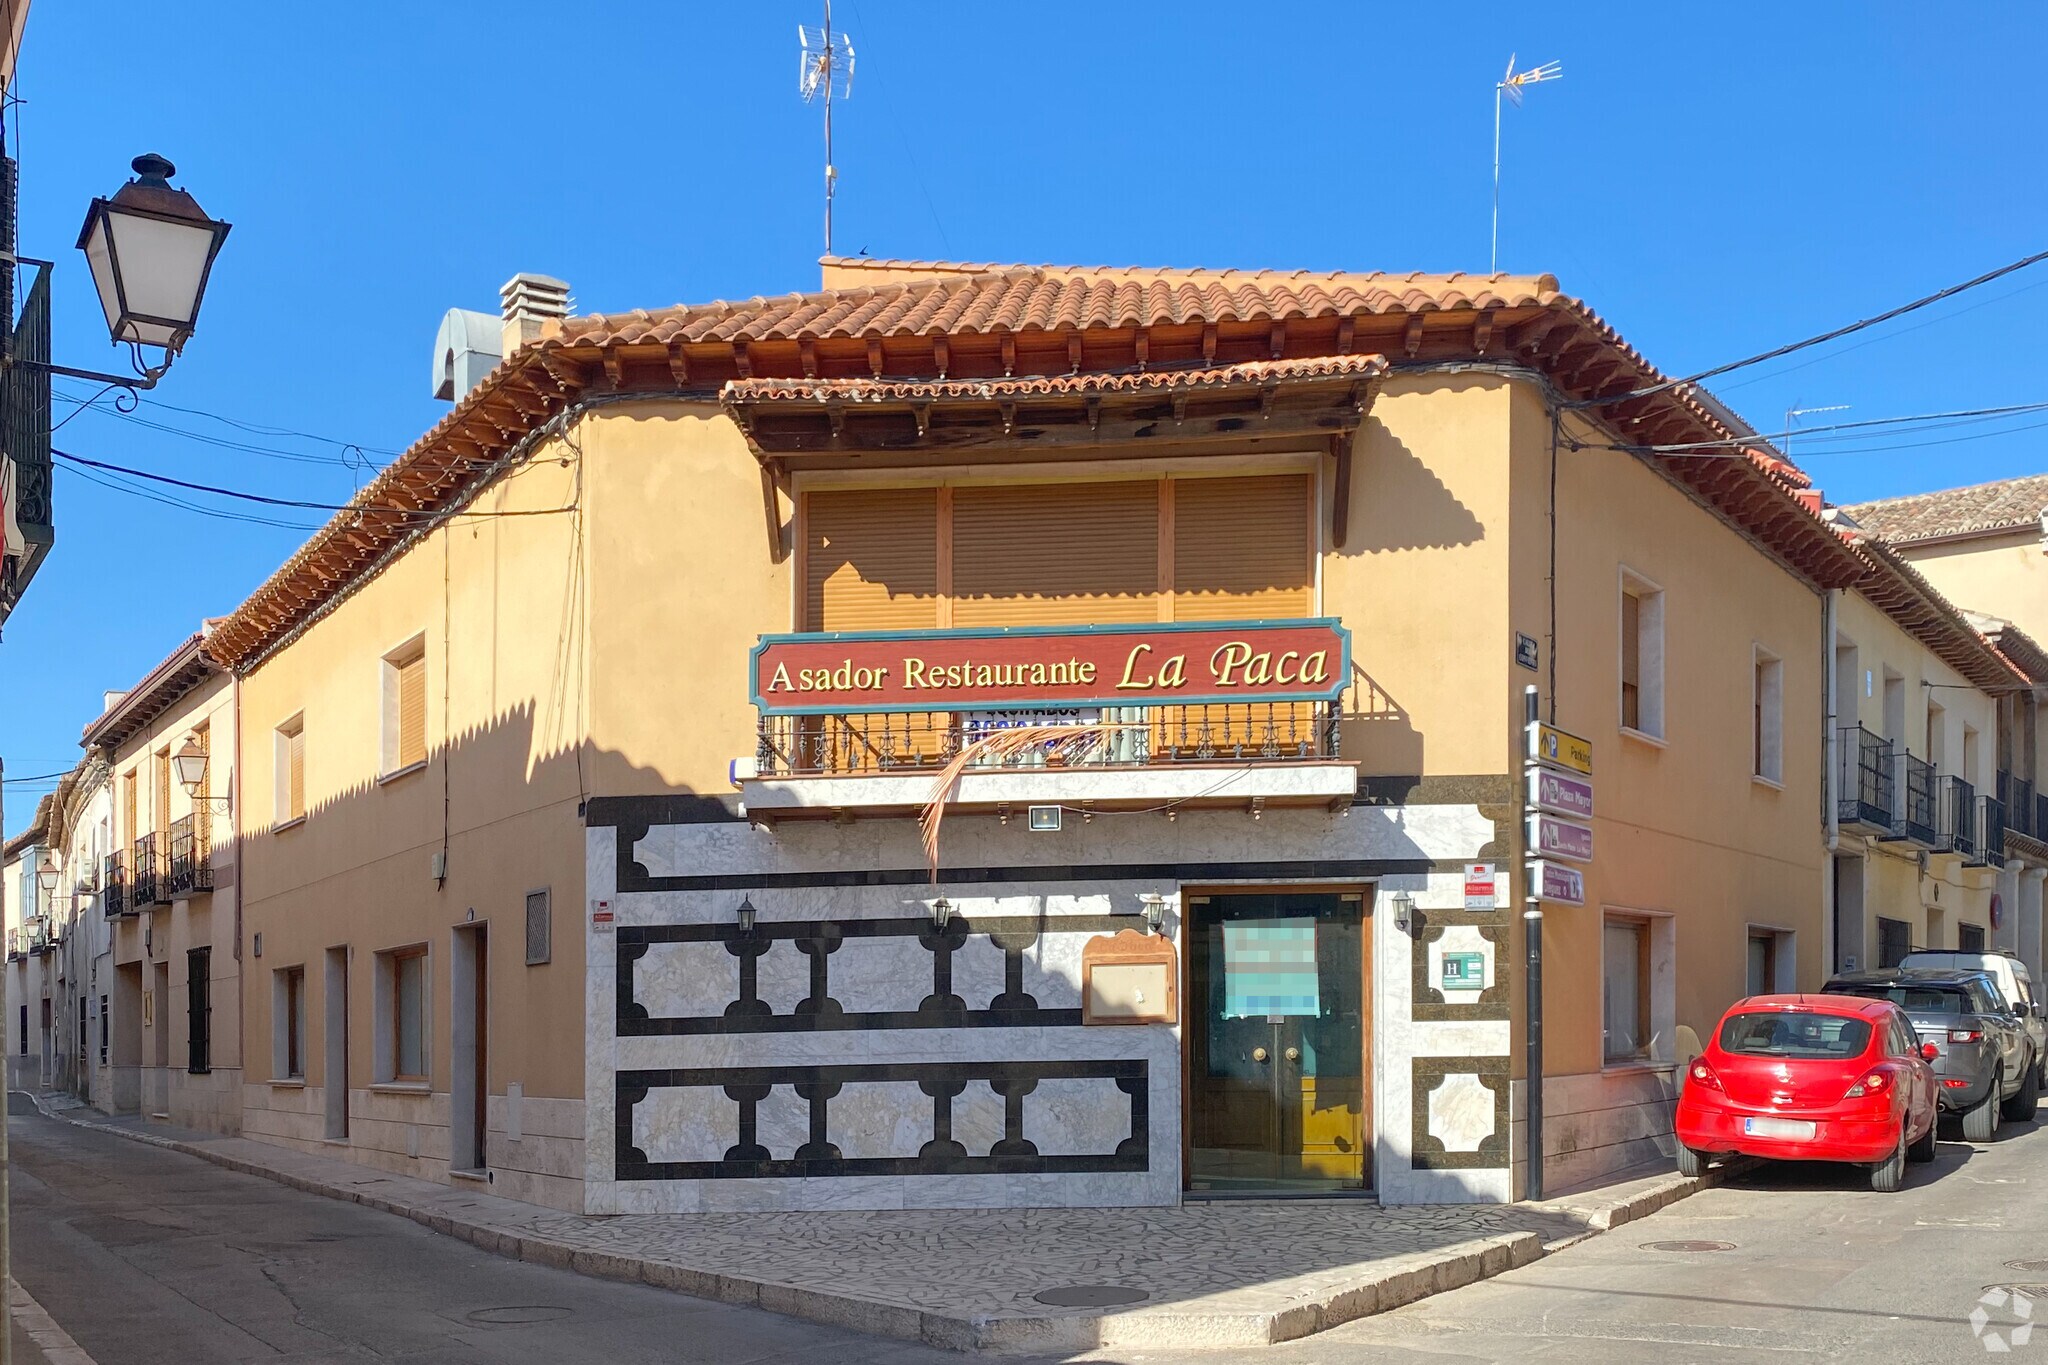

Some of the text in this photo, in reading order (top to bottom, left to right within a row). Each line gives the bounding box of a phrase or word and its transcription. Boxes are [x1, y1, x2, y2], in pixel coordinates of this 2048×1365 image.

[767, 640, 1330, 692] Asador Restaurante La Paca
[1570, 745, 1591, 767] Parking
[1559, 786, 1591, 809] Plaza Mayor
